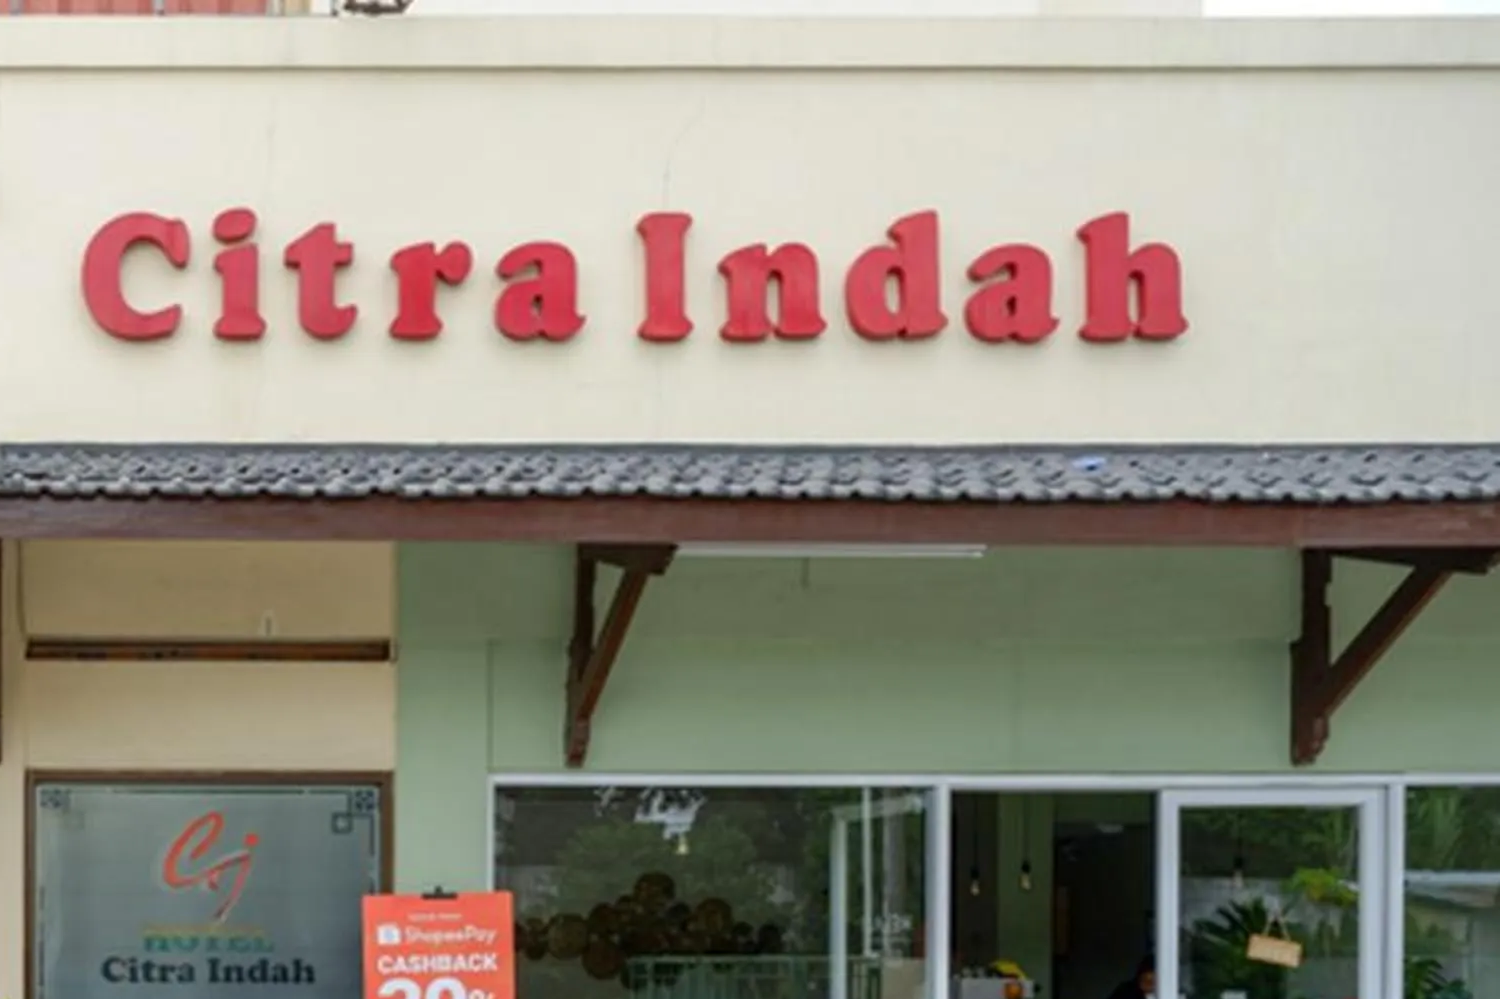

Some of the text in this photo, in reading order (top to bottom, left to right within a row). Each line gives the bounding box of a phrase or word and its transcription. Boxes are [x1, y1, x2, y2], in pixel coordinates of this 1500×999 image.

[80, 207, 1189, 345] Citra Indah
[101, 955, 317, 984] Citra Indah
[377, 952, 498, 975] CASHBACK
